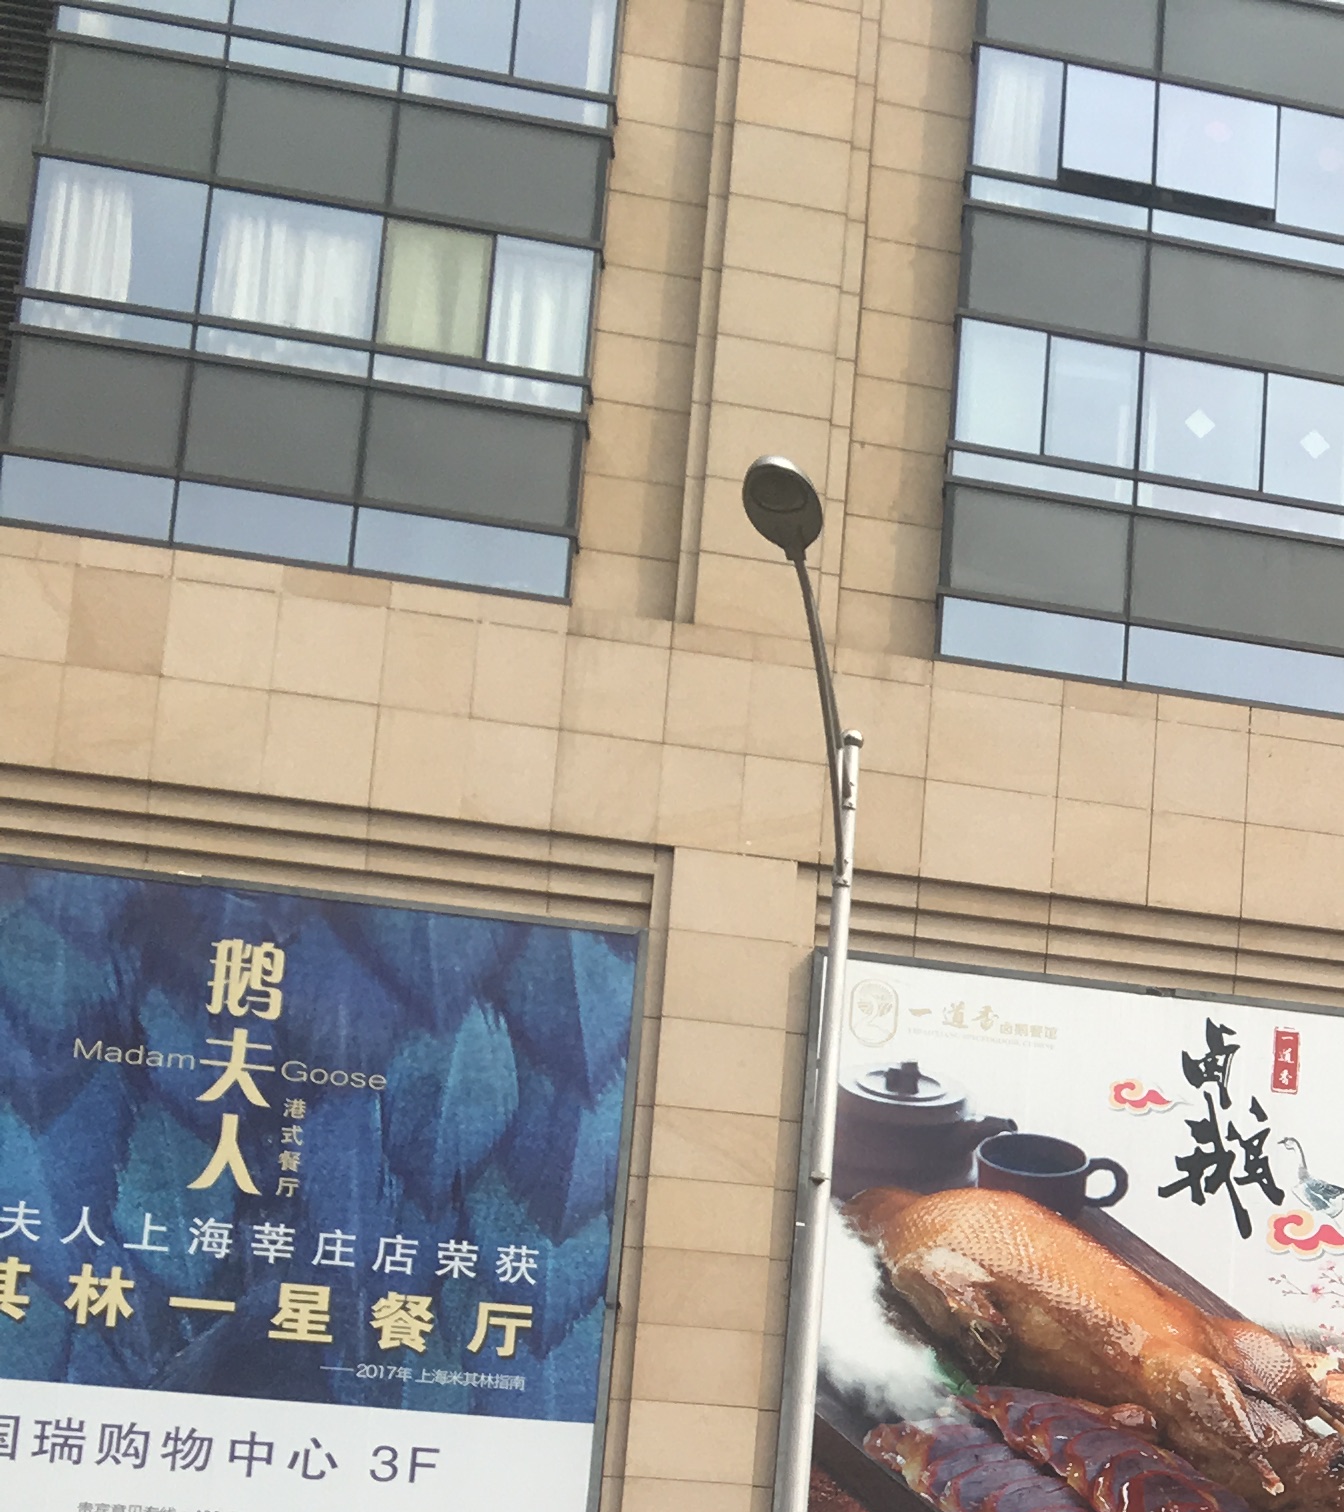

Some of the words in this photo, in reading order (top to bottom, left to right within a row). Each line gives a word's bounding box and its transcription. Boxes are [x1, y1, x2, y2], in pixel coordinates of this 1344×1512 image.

[73, 1038, 196, 1071] Madam
[281, 1060, 388, 1091] Goose
[186, 938, 286, 1196] 鹅夫人
[1277, 1035, 1295, 1086] 一道香
[275, 1097, 307, 1198] 港式餐厅
[0, 1200, 540, 1285] 夫人上海莘庄店荣获
[414, 1368, 526, 1391] 上海米其林指南
[369, 1445, 441, 1484] 3F
